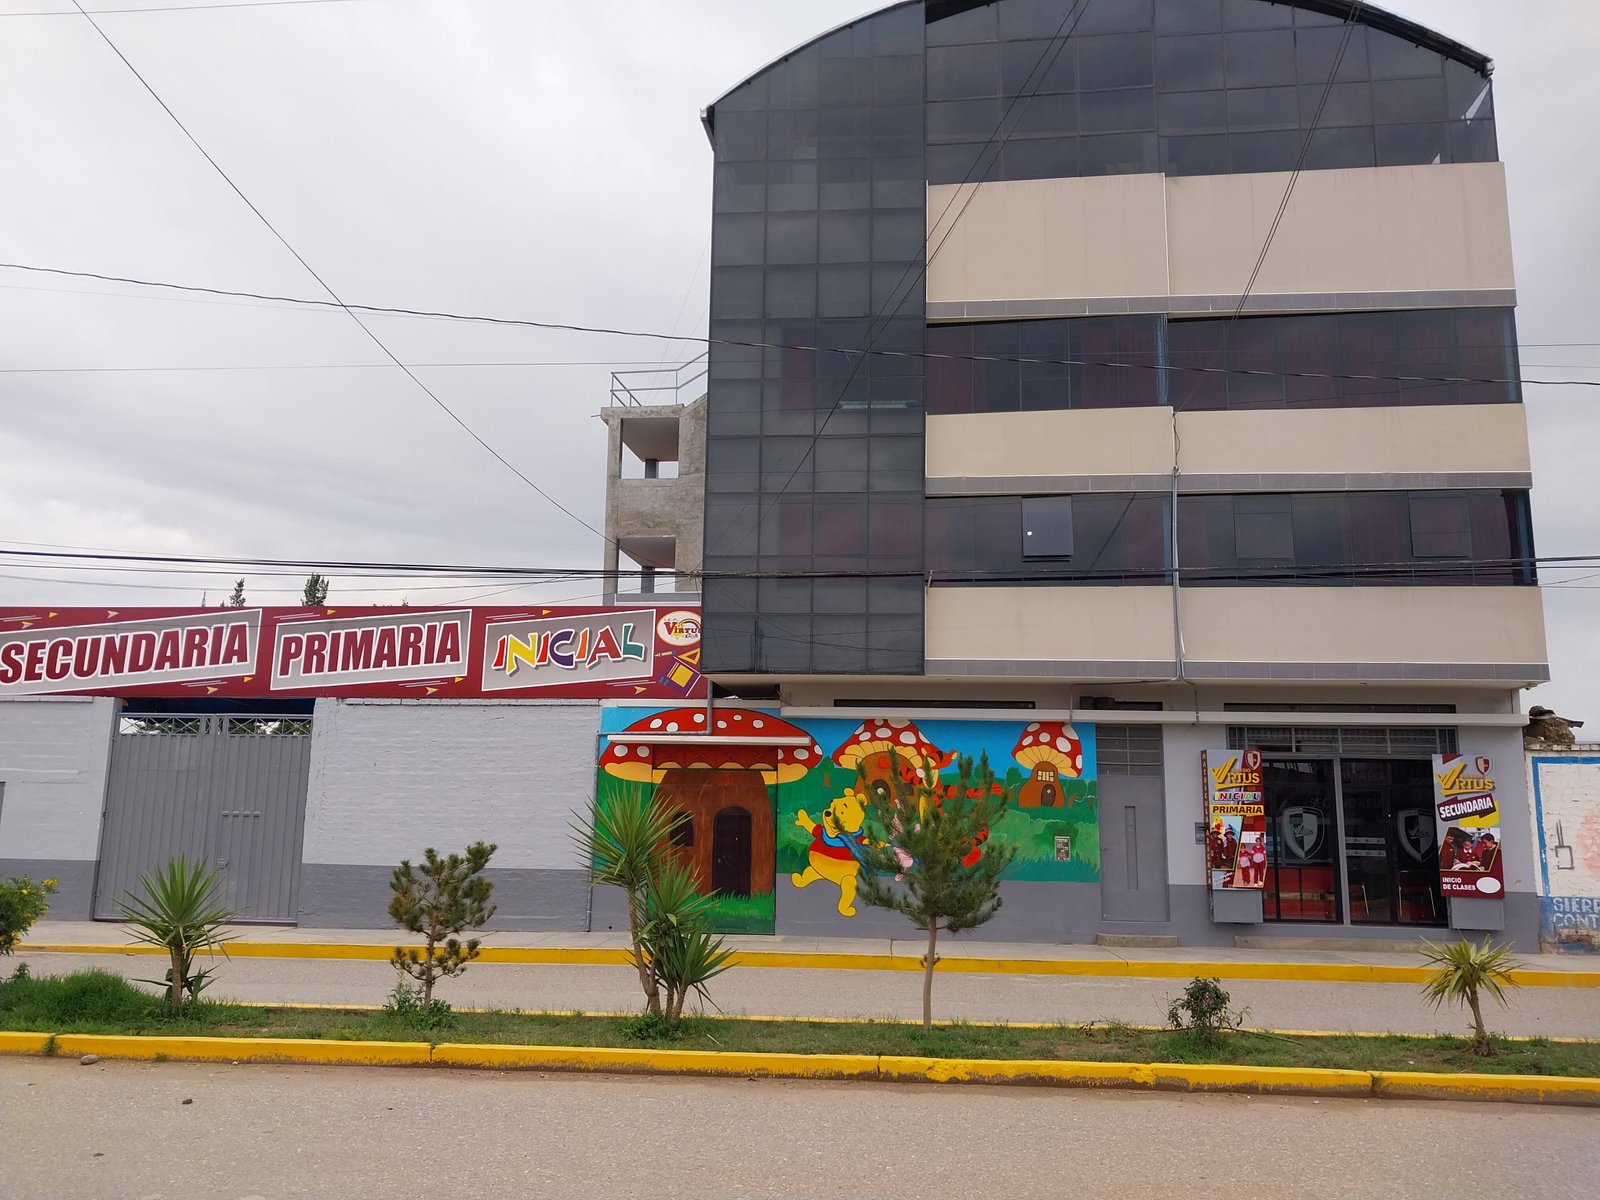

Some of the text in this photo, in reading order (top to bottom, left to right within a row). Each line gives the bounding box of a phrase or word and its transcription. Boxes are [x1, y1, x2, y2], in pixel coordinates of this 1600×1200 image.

[0, 623, 248, 685] SECUNDARIA
[278, 621, 461, 678] PRIMARIA
[491, 623, 645, 676] INICIAL
[1212, 805, 1263, 814] PRIMARIA
[1214, 792, 1259, 801] INICIAL
[1439, 796, 1493, 819] SECUNDARIA
